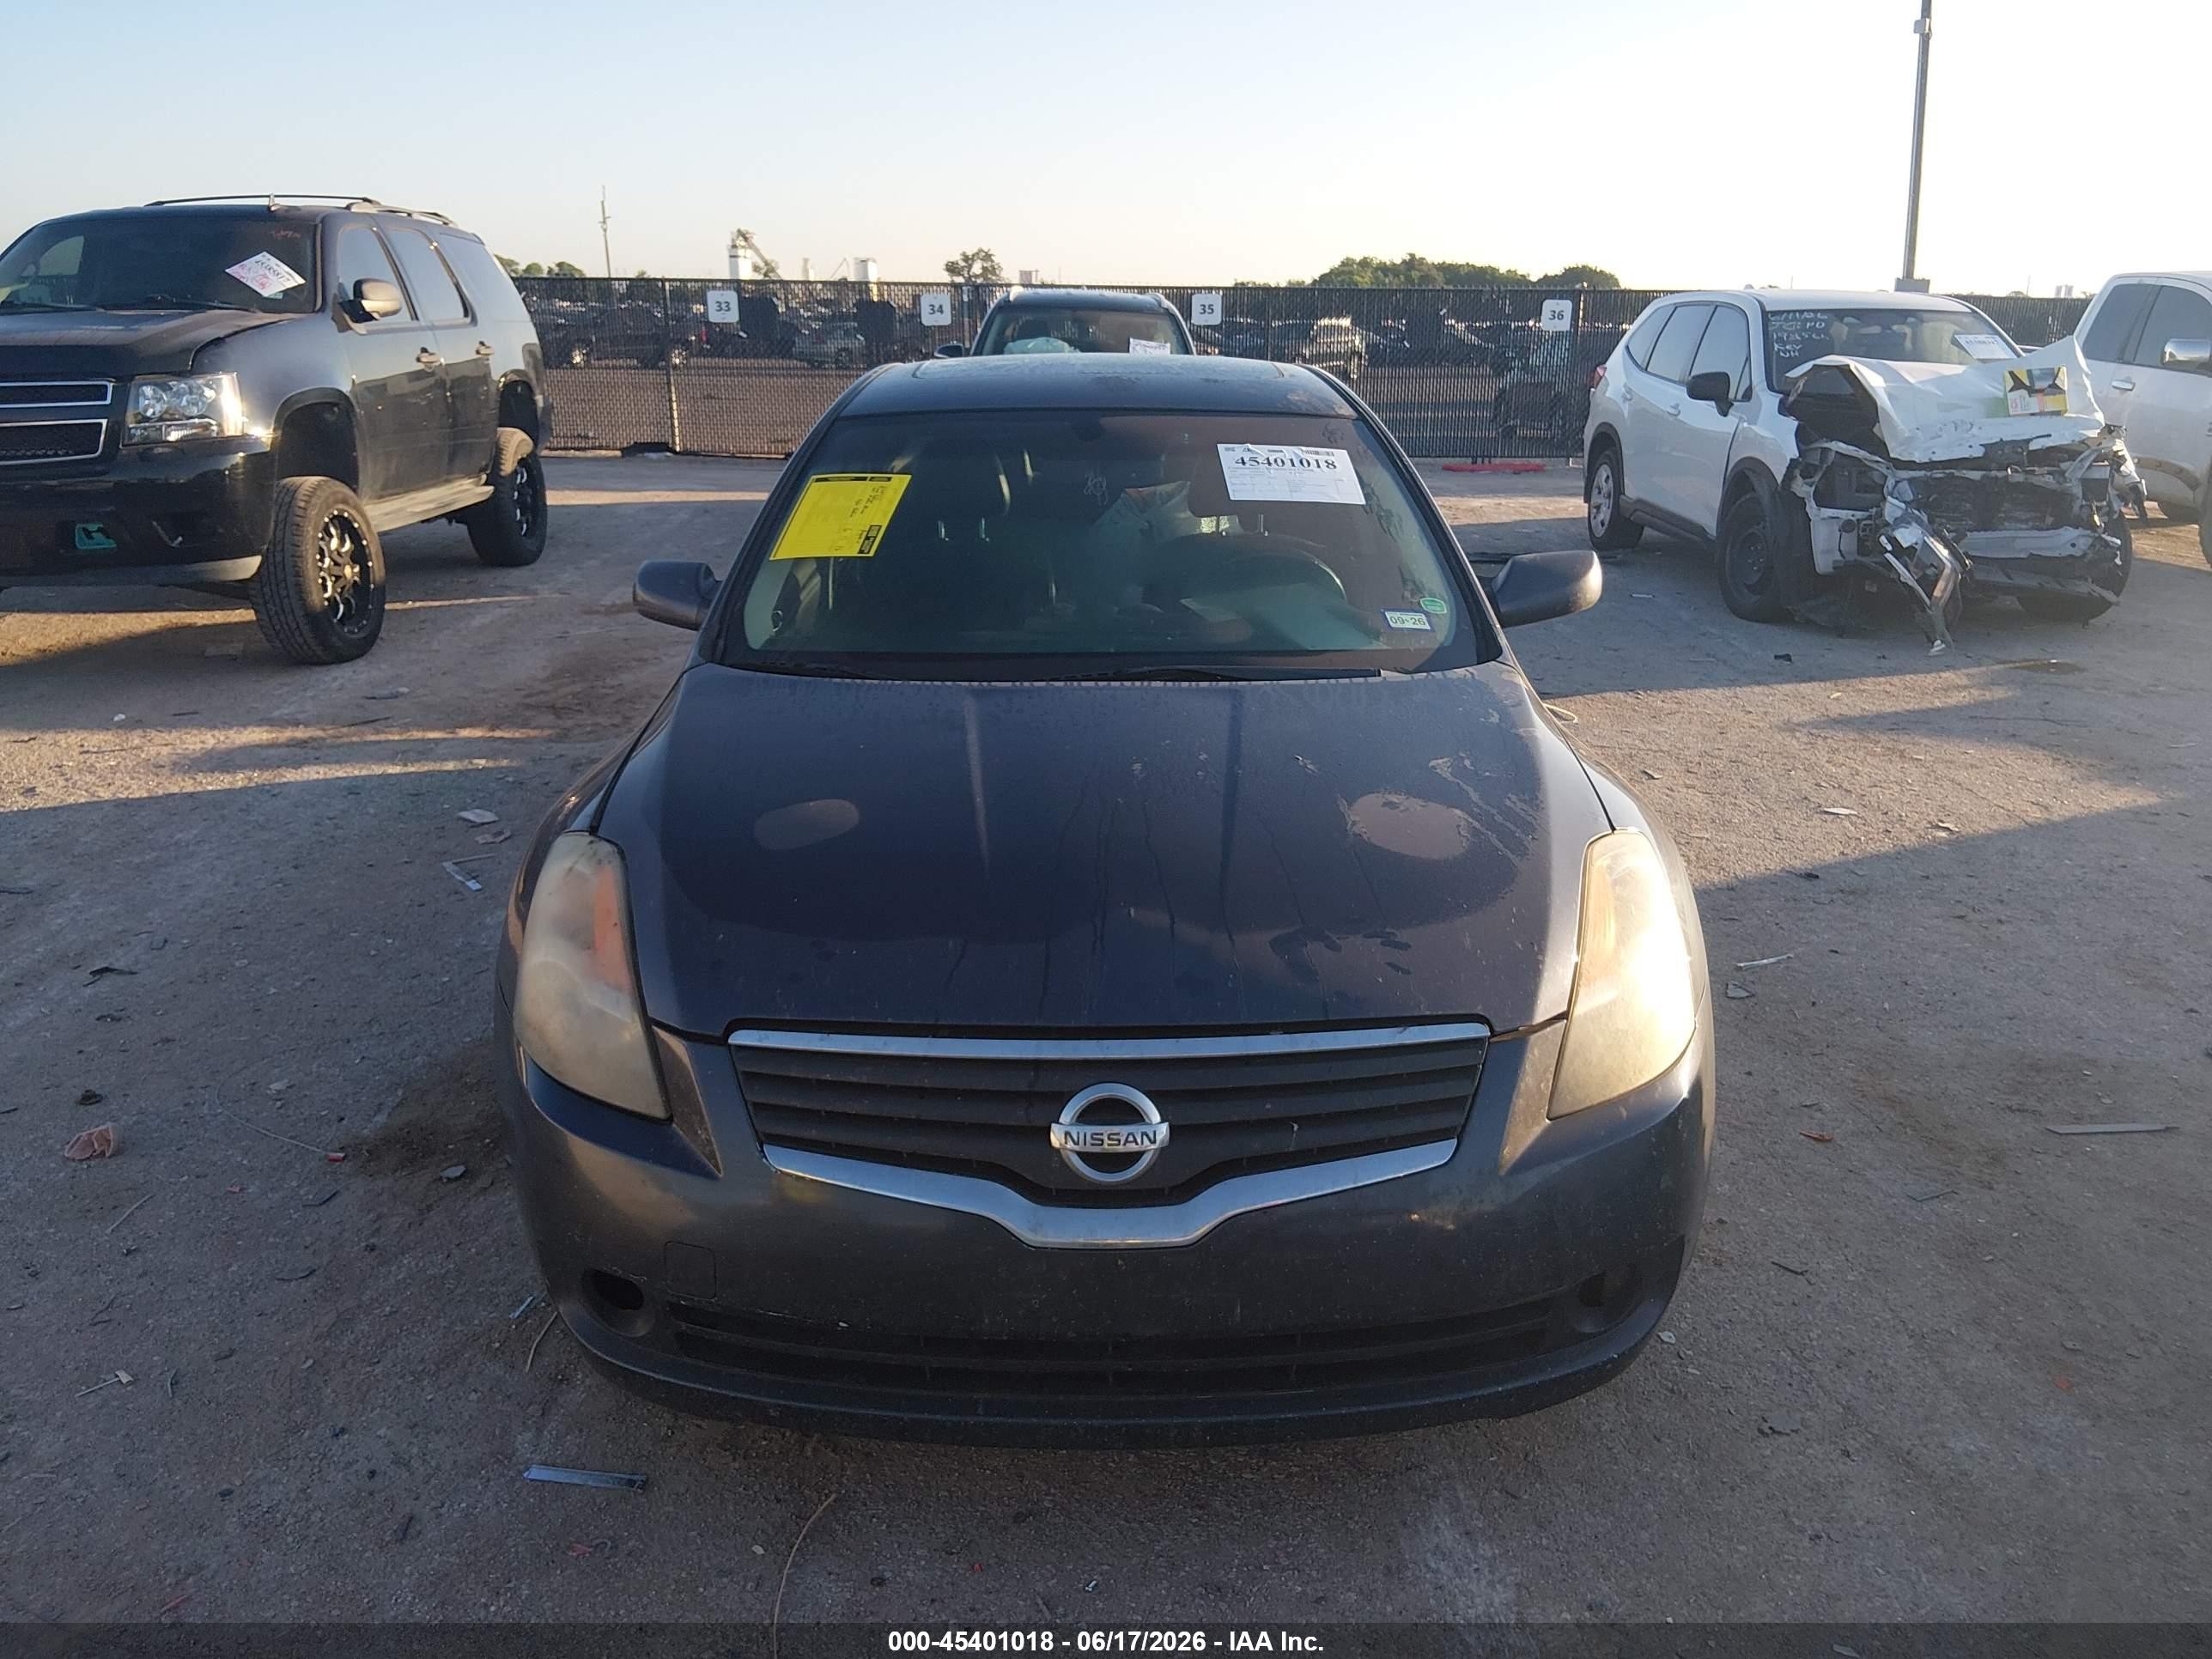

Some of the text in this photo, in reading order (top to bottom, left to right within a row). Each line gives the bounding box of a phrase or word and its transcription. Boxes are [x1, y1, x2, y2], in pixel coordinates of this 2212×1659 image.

[714, 301, 731, 312] 33
[928, 303, 945, 315] 34
[1199, 303, 1215, 315] 35
[1548, 309, 1565, 321] 36
[1235, 455, 1338, 471] 45401018
[1064, 1129, 1157, 1147] NISSAN
